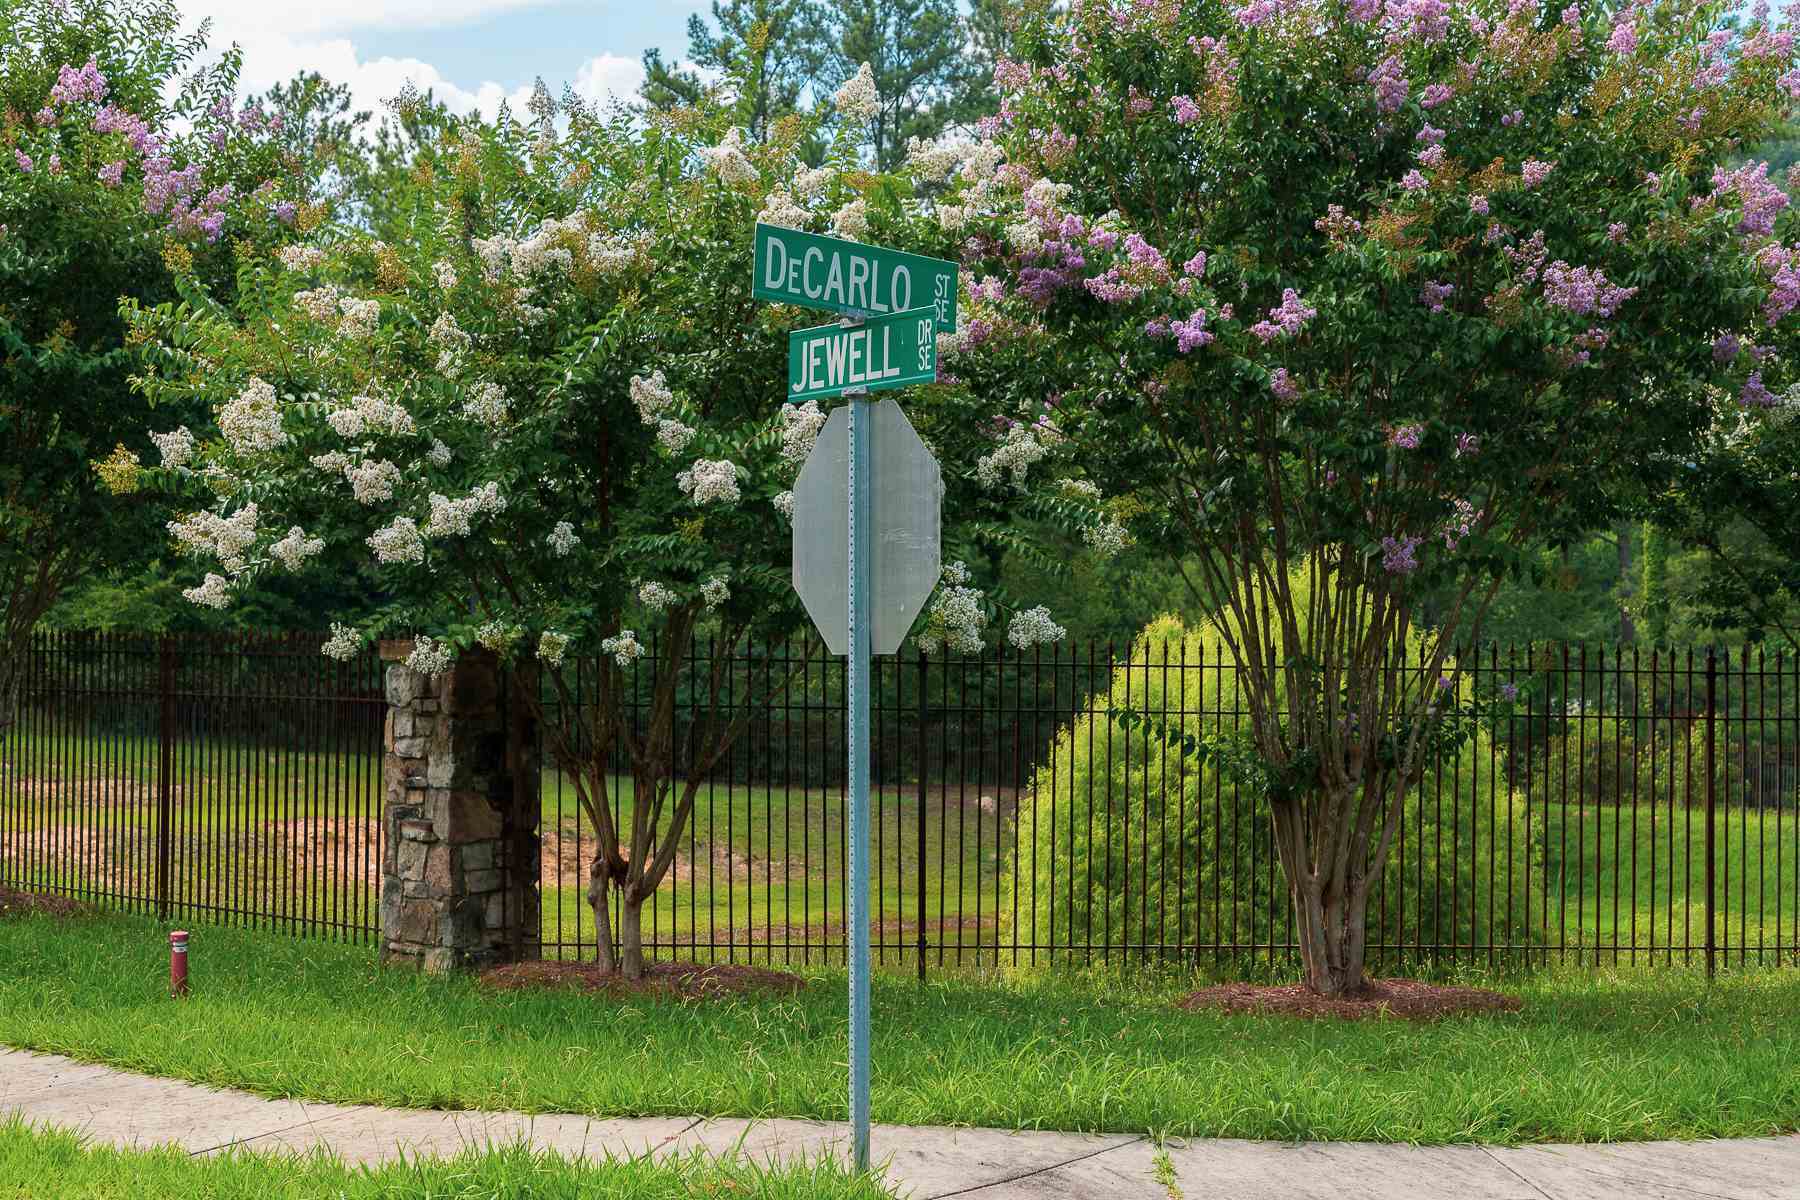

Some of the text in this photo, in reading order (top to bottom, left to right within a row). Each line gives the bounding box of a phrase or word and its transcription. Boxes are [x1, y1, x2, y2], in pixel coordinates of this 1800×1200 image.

[934, 273, 950, 298] ST
[934, 298, 949, 323] SE
[917, 319, 932, 345] DR
[791, 325, 900, 392] JEWELL
[918, 345, 932, 371] SE
